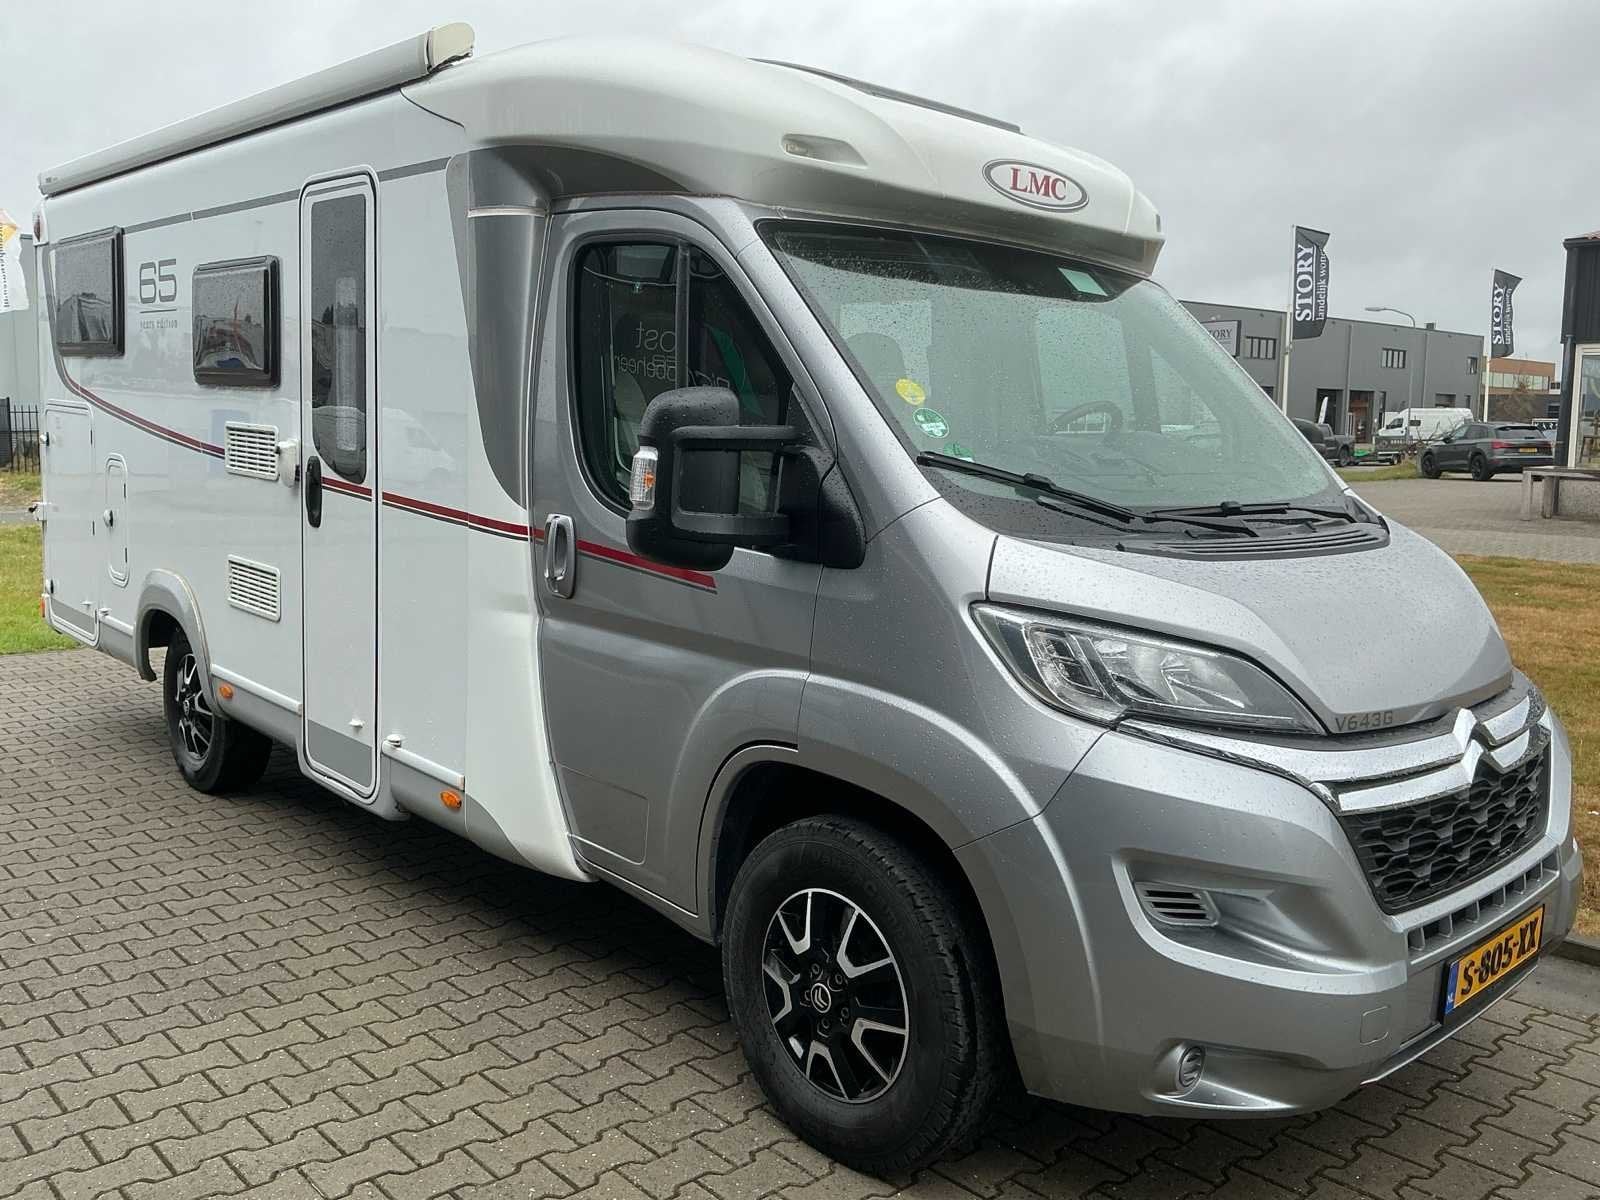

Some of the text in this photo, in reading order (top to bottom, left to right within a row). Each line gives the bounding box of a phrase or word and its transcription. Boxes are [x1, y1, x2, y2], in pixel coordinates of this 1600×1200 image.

[1010, 167, 1066, 201] LMC
[139, 258, 177, 304] 65
[1295, 244, 1313, 321] STORY
[1316, 248, 1328, 321] landelijk won
[1493, 282, 1504, 345] STORY
[1460, 916, 1539, 996] S-805-XX
